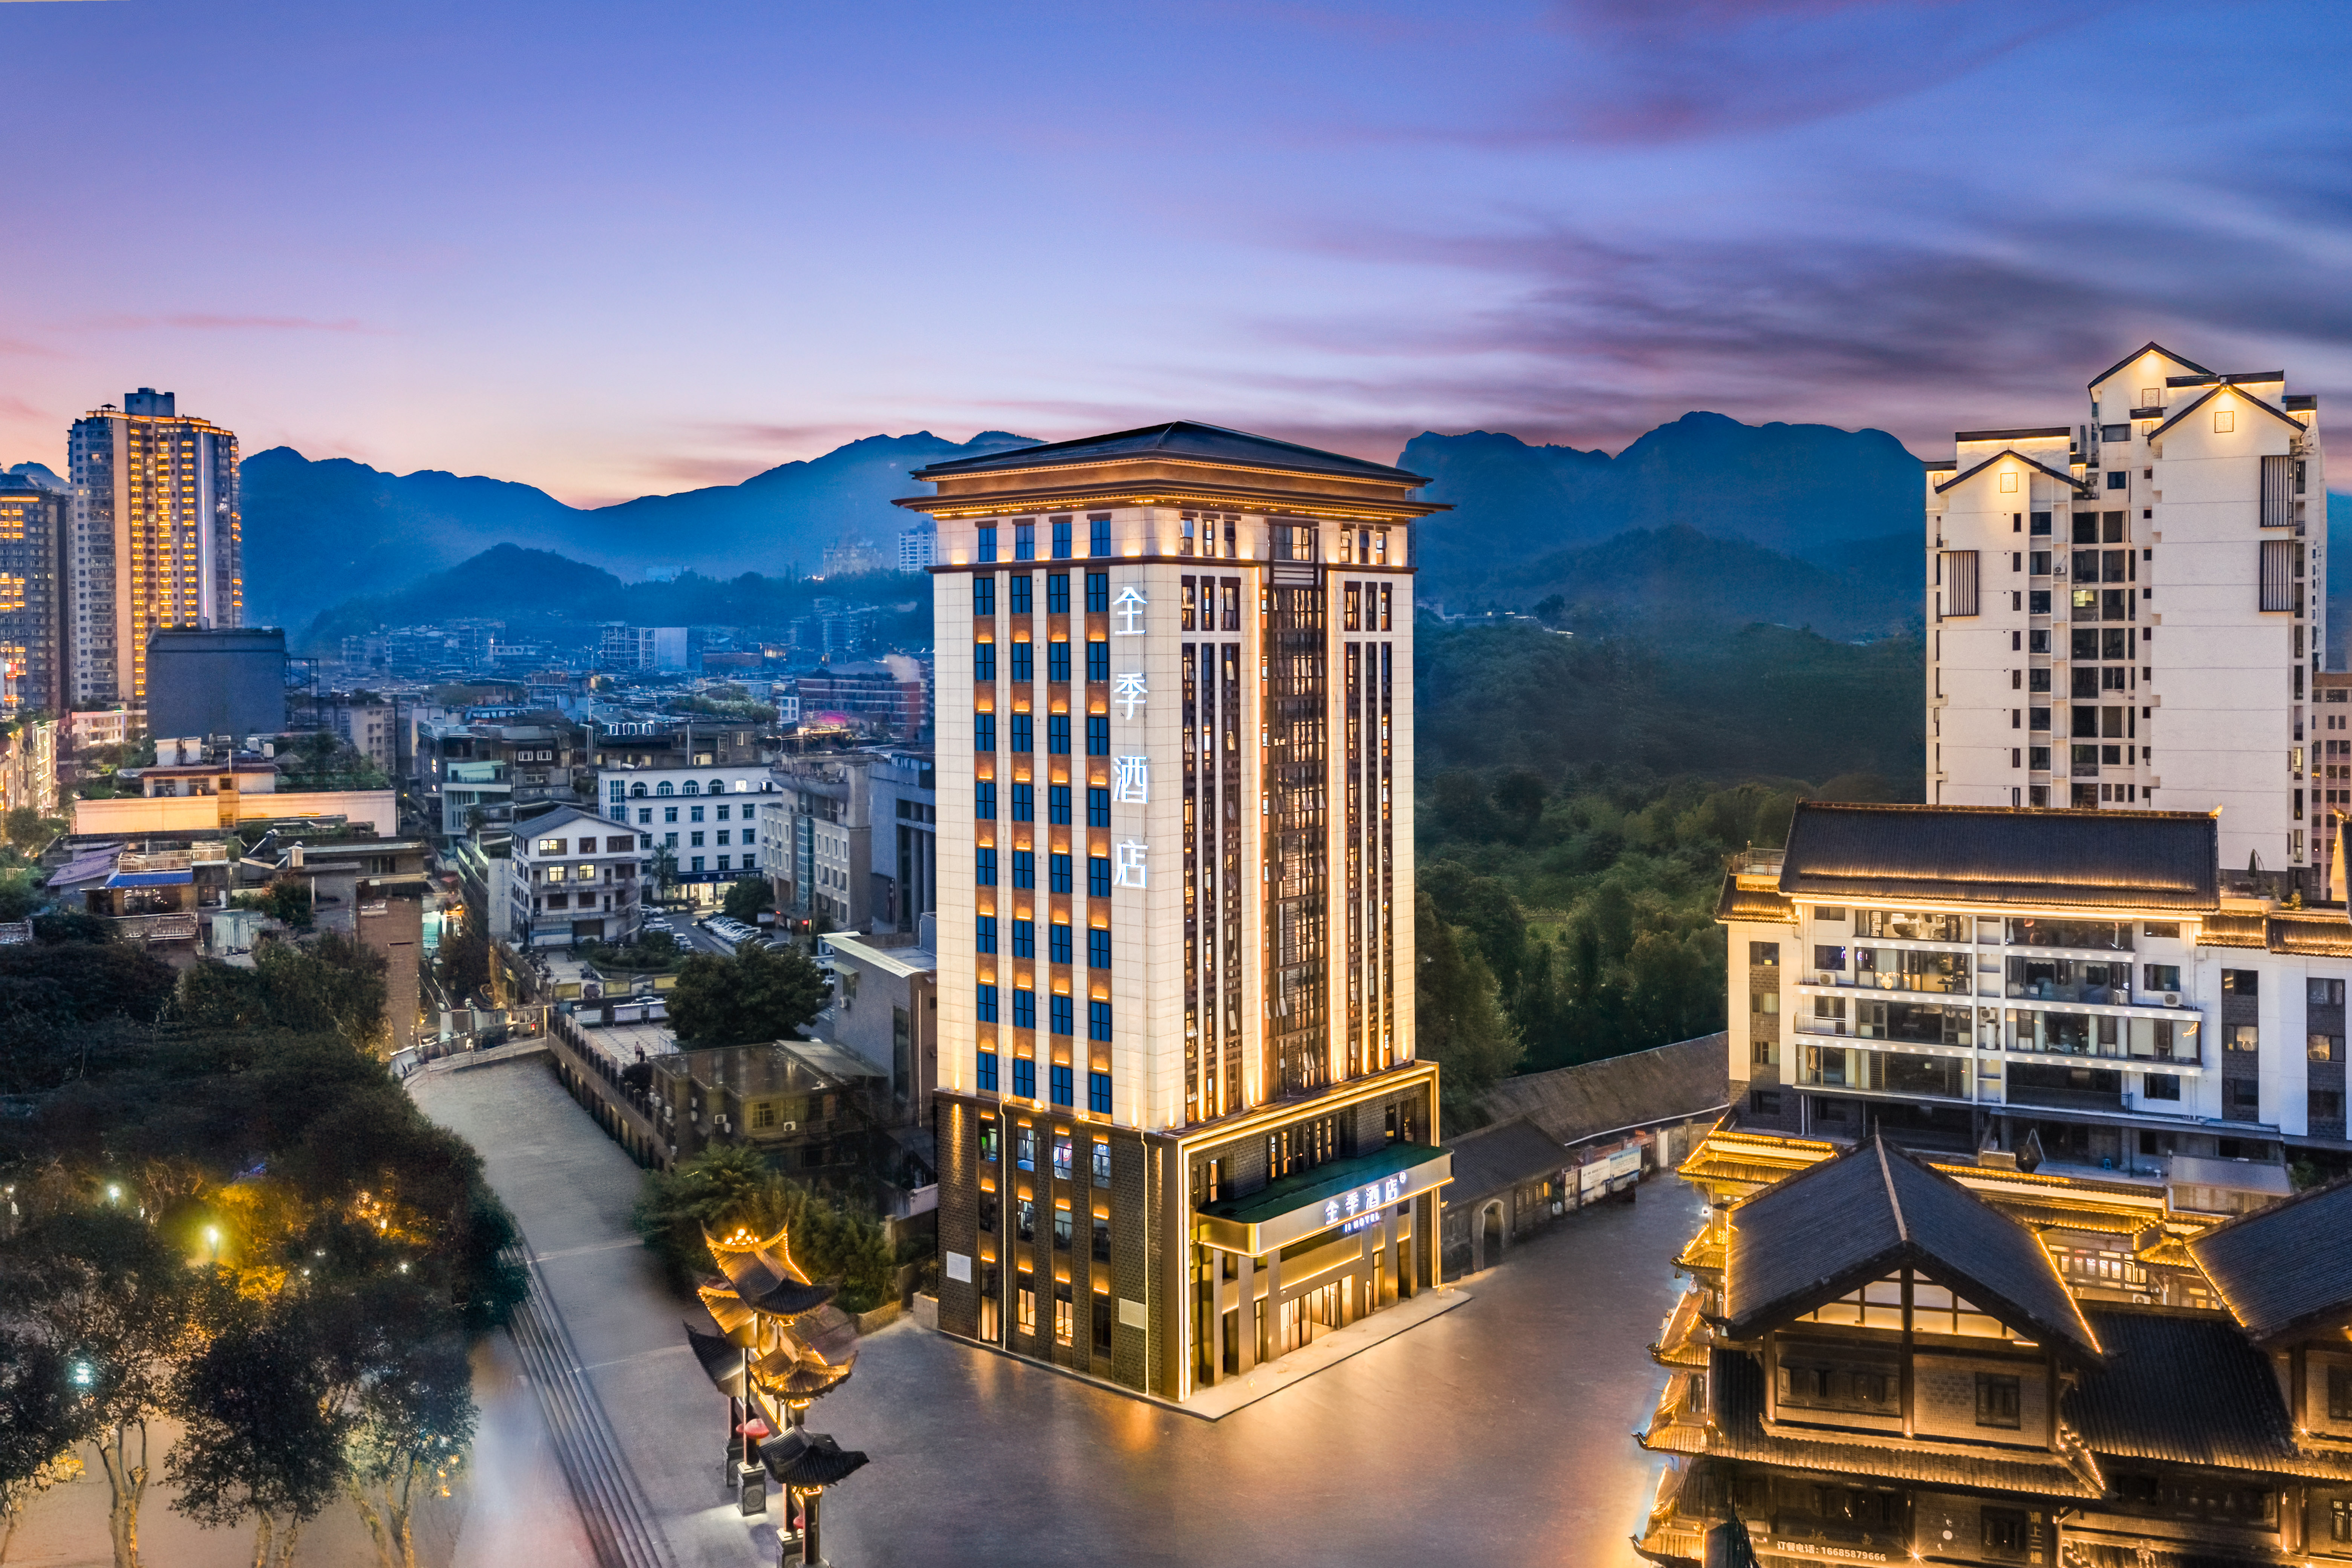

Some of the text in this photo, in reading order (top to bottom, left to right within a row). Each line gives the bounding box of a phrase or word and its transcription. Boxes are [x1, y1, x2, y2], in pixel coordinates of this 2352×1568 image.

[1113, 586, 1149, 888] 全季酒店
[1325, 1178, 1398, 1225] 全季酒店
[1354, 1212, 1380, 1229] HOTEL
[2029, 1511, 2043, 1564] 请上二楼
